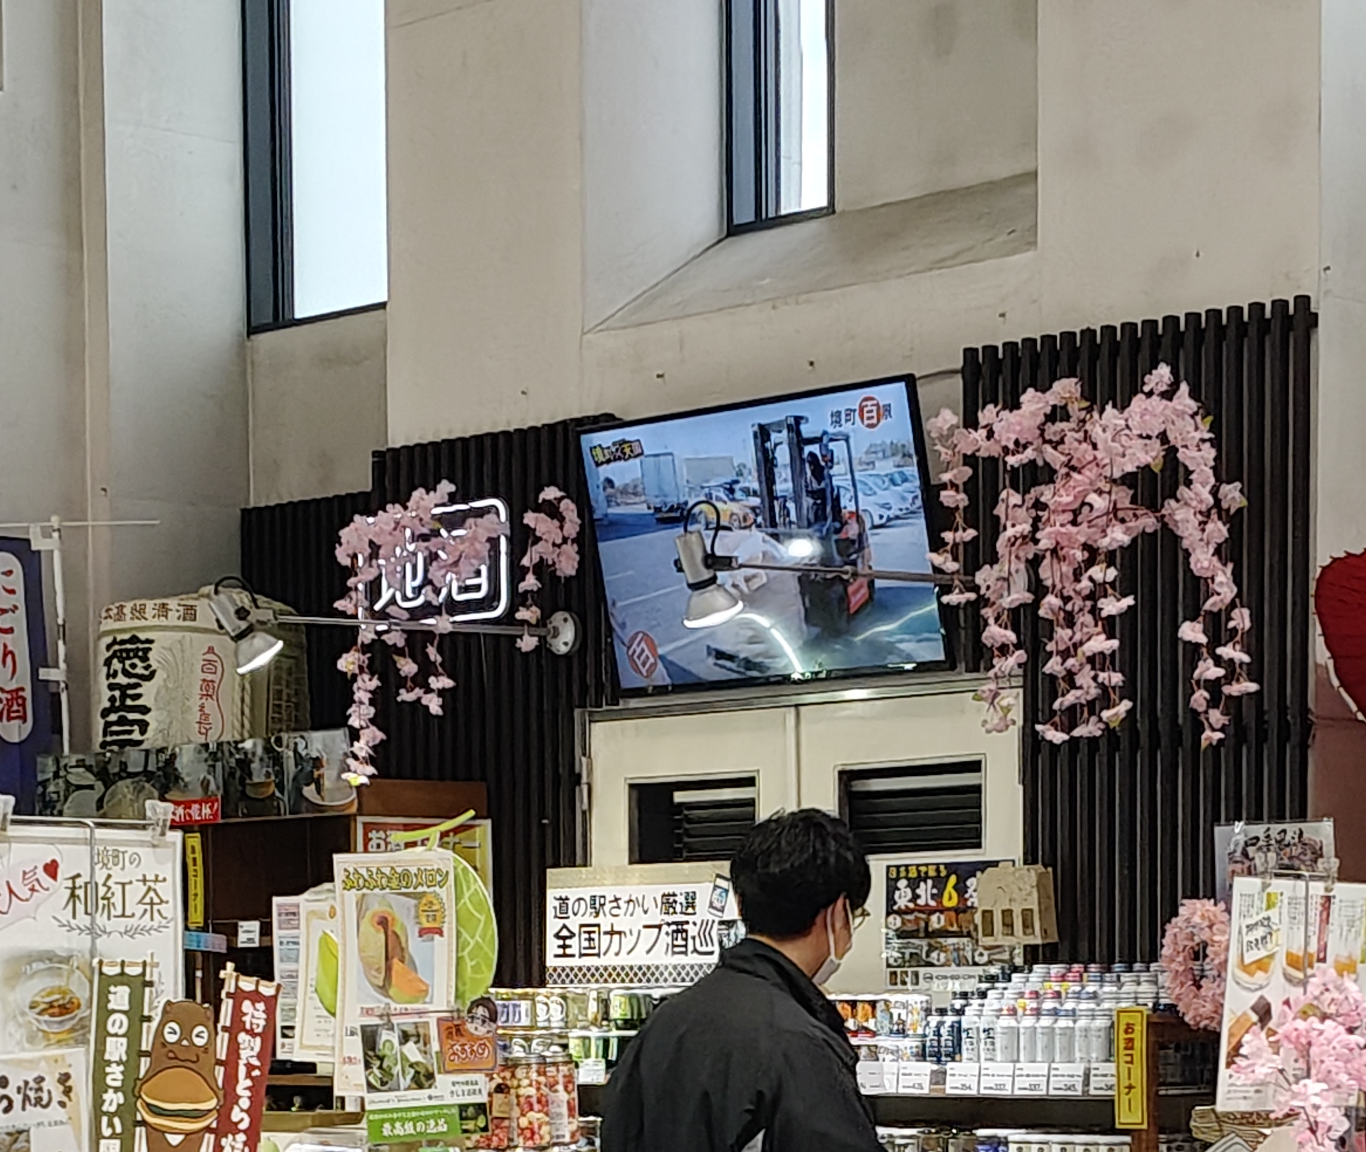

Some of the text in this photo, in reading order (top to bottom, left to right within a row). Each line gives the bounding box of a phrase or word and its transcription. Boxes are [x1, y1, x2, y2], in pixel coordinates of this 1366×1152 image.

[95, 846, 142, 871] 境町の
[62, 872, 170, 923] 和紅茶
[551, 890, 698, 920] 道の駅さかい厳選
[551, 919, 717, 960] 全国カップ酒巡
[1121, 1022, 1137, 1114] お酒コーナー
